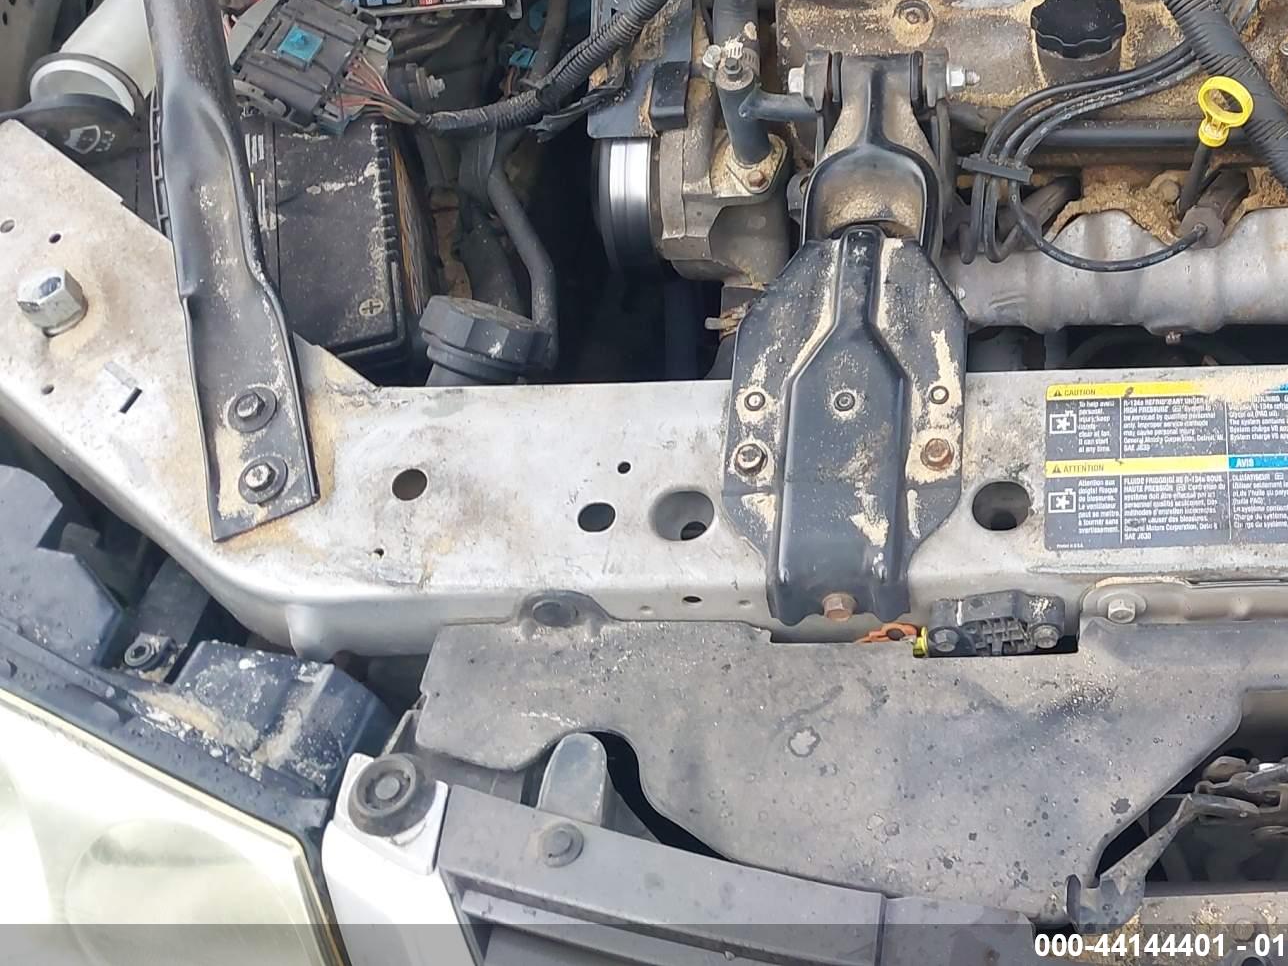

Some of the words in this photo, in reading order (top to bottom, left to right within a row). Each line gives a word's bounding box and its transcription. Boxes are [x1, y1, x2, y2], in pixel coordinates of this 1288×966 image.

[1065, 388, 1095, 396] CAUTION
[1236, 458, 1254, 467] AVIS
[1063, 465, 1104, 473] ATTENTION
